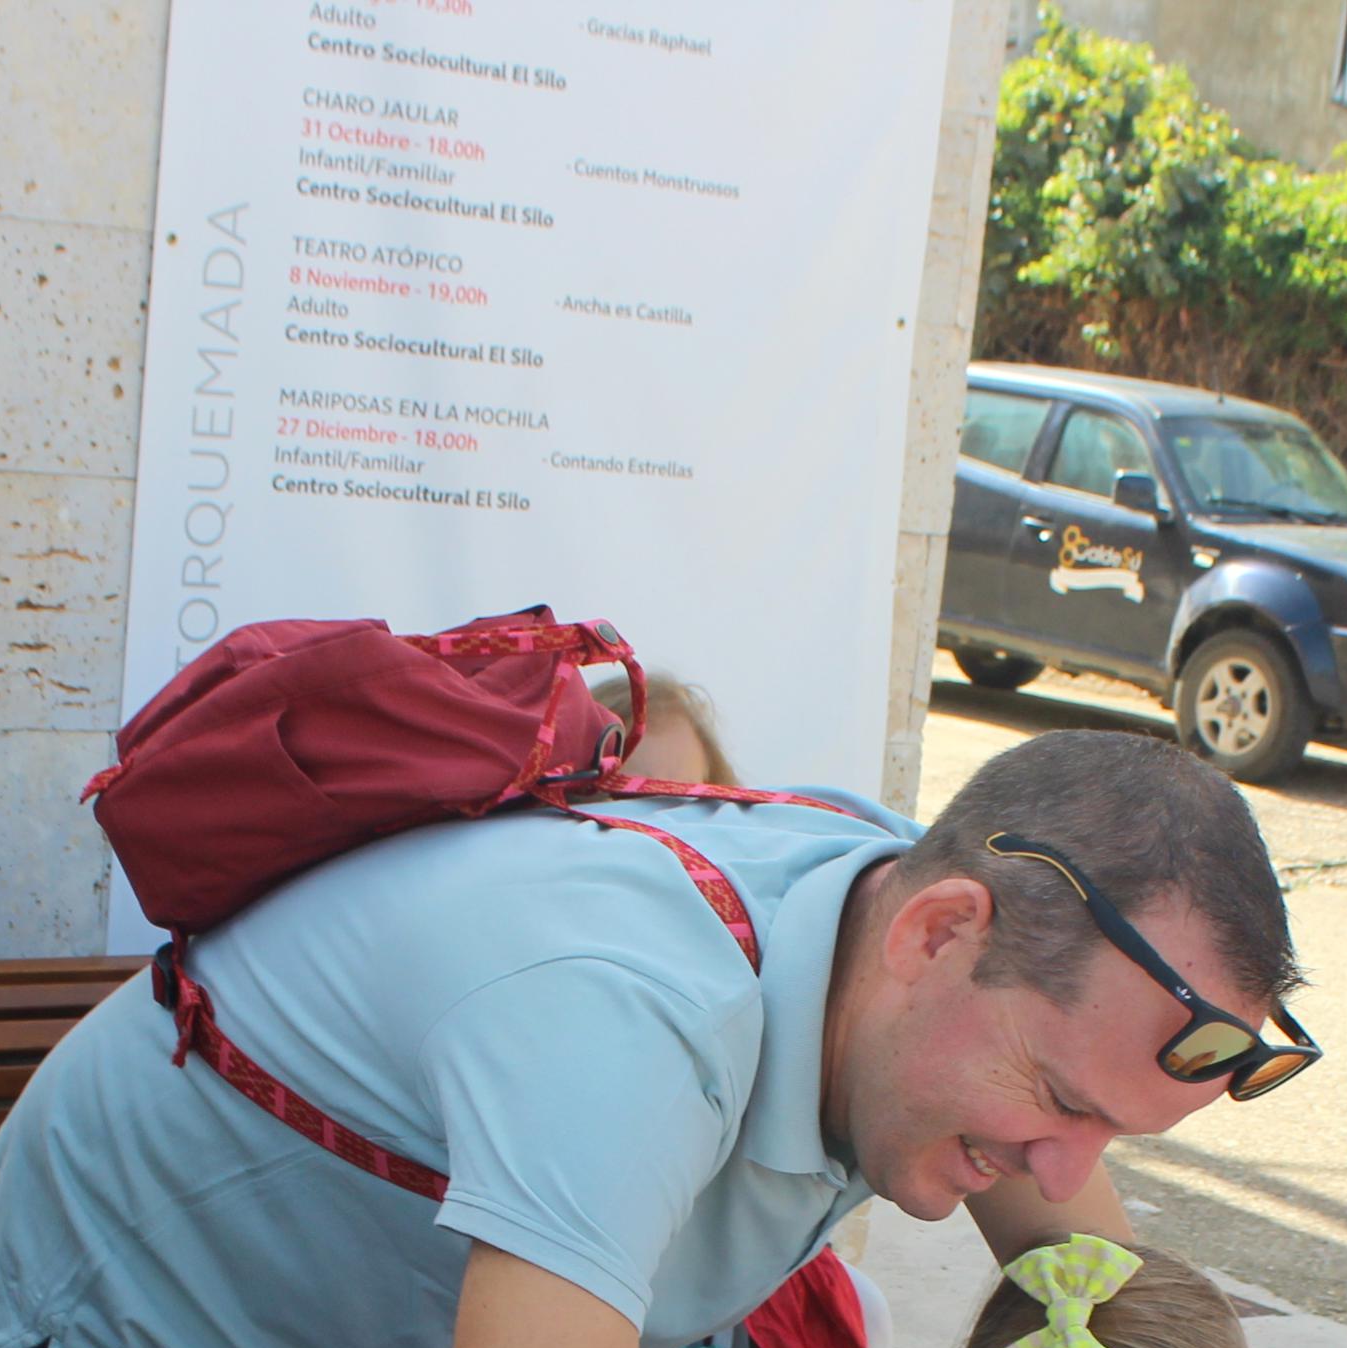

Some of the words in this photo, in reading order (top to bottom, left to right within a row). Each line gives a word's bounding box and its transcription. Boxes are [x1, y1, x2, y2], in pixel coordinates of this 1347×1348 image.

[309, 3, 377, 30] Adulto
[586, 18, 645, 44] Gracias
[649, 31, 713, 57] Raphael
[307, 31, 376, 59] Centro
[382, 43, 507, 81] Sociocultural
[511, 65, 529, 84] El
[533, 69, 567, 91] Silo
[302, 87, 375, 116] CHARO
[380, 100, 459, 128] JAULAR
[301, 118, 323, 138] 31
[328, 122, 410, 151] Octubre
[427, 136, 486, 162] 18,00h
[298, 148, 456, 185] Infantil/Familiar
[574, 158, 640, 184] Cuentos
[643, 168, 740, 199] Monstruosos
[296, 178, 361, 202] Centro
[366, 186, 496, 221] Sociocultural
[500, 205, 517, 224] El
[521, 207, 555, 228] Silo
[292, 236, 367, 263] TEATRO
[372, 244, 463, 274] ATÓPICO
[289, 267, 301, 284] 8
[306, 270, 410, 297] Noviembre
[427, 282, 488, 306] 19,00h
[286, 295, 349, 319] Adulto
[563, 295, 612, 317] Ancha
[615, 306, 633, 319] es
[636, 303, 693, 326] Castilla
[284, 325, 349, 347] Centro
[354, 332, 484, 362] Sociocultural
[489, 347, 506, 364] El
[511, 347, 544, 368] Silo
[279, 388, 393, 415] MARIPOSAS
[398, 398, 427, 418] EN
[434, 402, 459, 421] LA
[465, 405, 550, 431] MOCHILA
[276, 417, 300, 436] 27
[305, 419, 398, 445] Diciembre
[414, 429, 478, 453] 18,00h
[273, 446, 425, 475] Infantil/Familiar
[550, 451, 625, 474] Contando
[628, 458, 694, 480] Estrellas
[272, 475, 339, 498] Centro
[343, 479, 470, 508] Sociocultural
[475, 490, 492, 509] El
[496, 490, 531, 512] Silo
